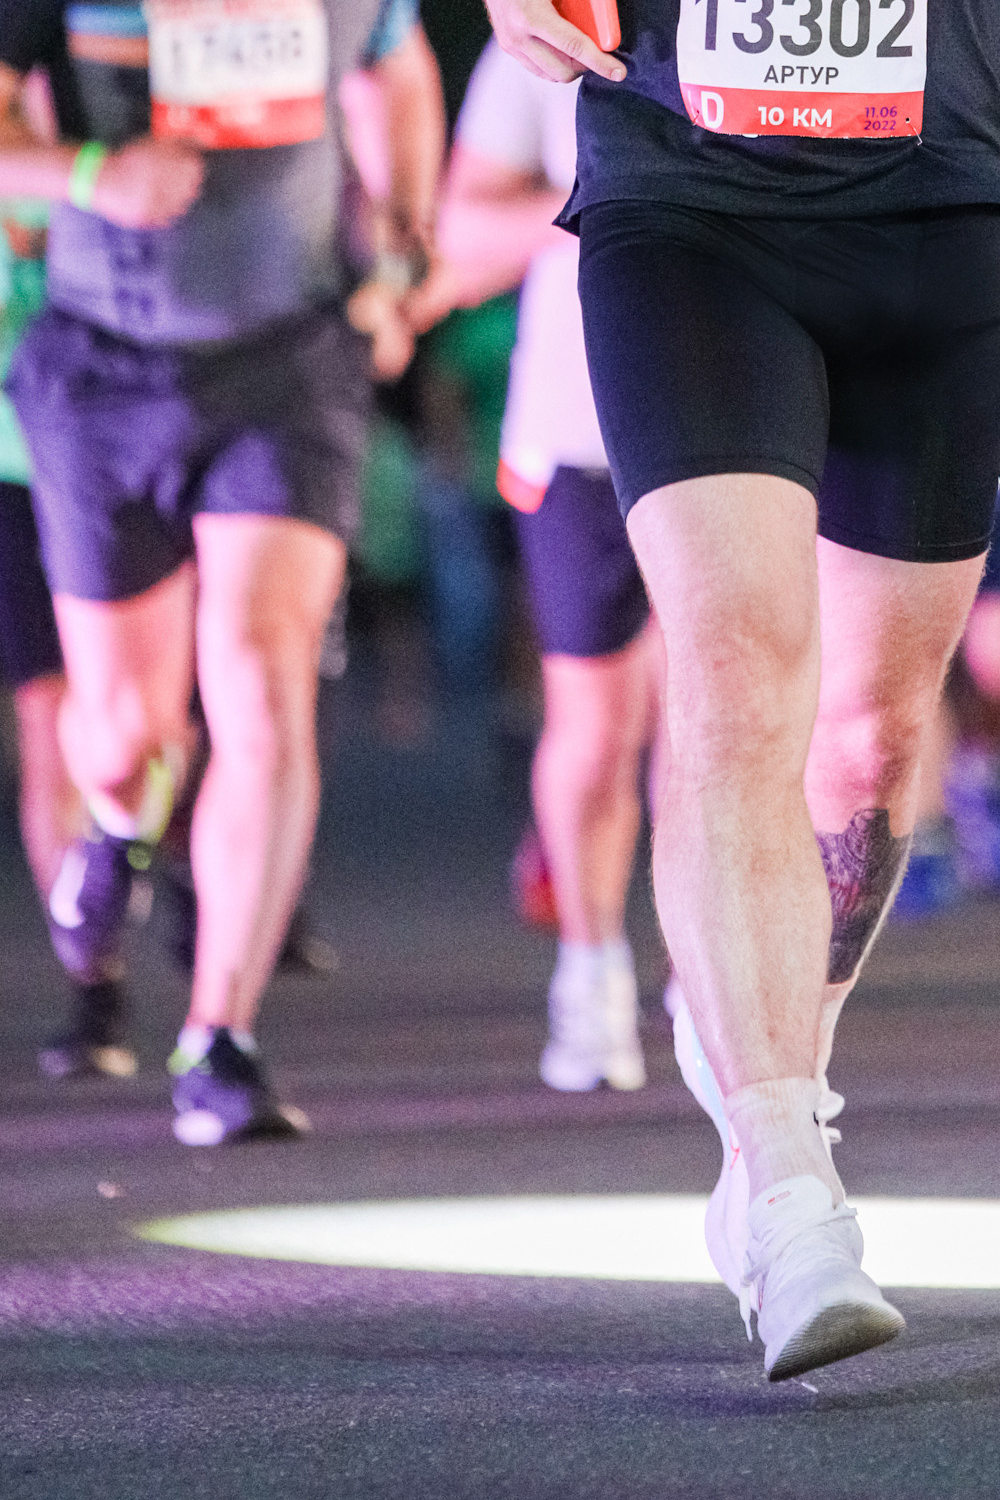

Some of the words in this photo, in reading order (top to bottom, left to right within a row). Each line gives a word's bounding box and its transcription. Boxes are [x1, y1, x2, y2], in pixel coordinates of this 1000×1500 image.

[764, 65, 840, 85] АРТУР
[701, 91, 724, 129] D
[758, 106, 785, 126] 10
[865, 106, 898, 118] 11.06
[864, 120, 897, 131] 2022
